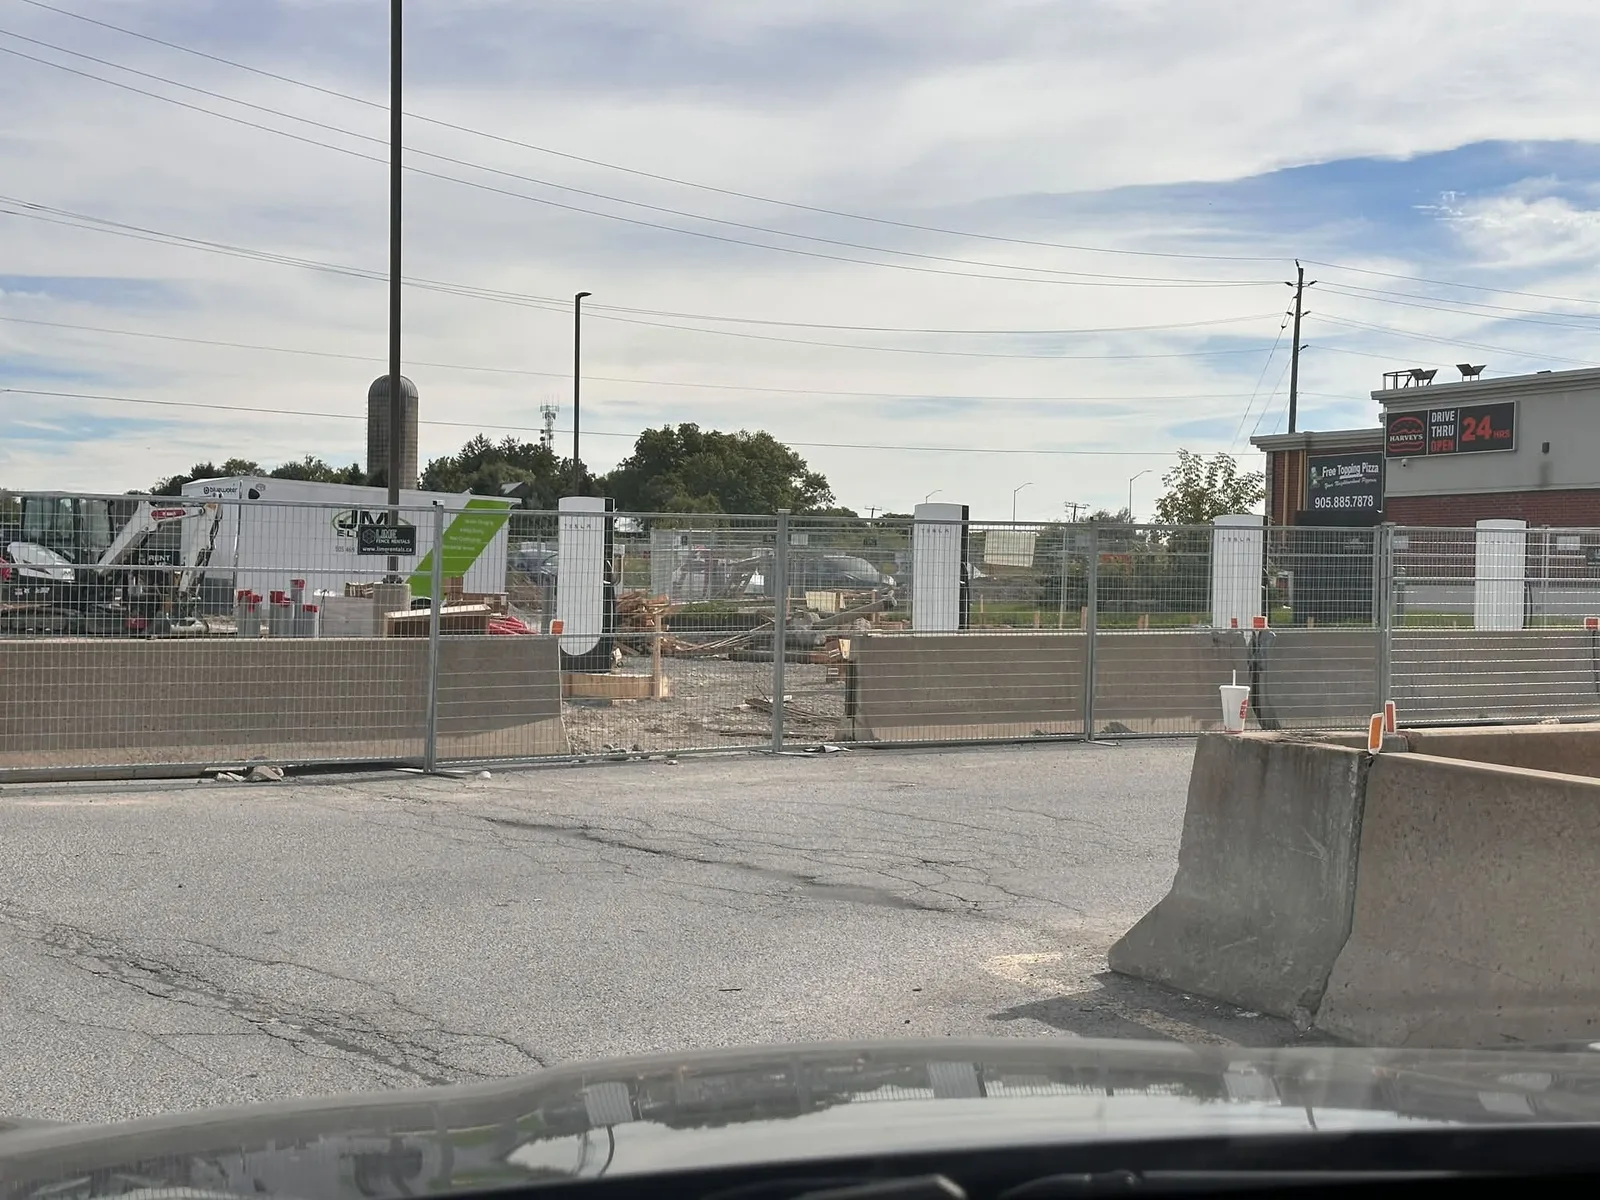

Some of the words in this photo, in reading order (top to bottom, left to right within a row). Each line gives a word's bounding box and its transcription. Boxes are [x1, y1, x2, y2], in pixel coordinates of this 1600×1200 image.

[1431, 410, 1455, 423] DRIVE
[1431, 424, 1454, 438] THRU
[1461, 415, 1492, 442] 24
[1493, 429, 1510, 439] HRS
[1389, 433, 1423, 442] HARVEY'S
[1431, 439, 1454, 452] OPEN
[1322, 466, 1337, 478] Free
[1337, 463, 1361, 476] Topping
[1361, 462, 1379, 473] Pizza
[1314, 495, 1374, 509] 905.885.7878
[375, 528, 398, 539] LIME
[148, 554, 170, 562] RENT
